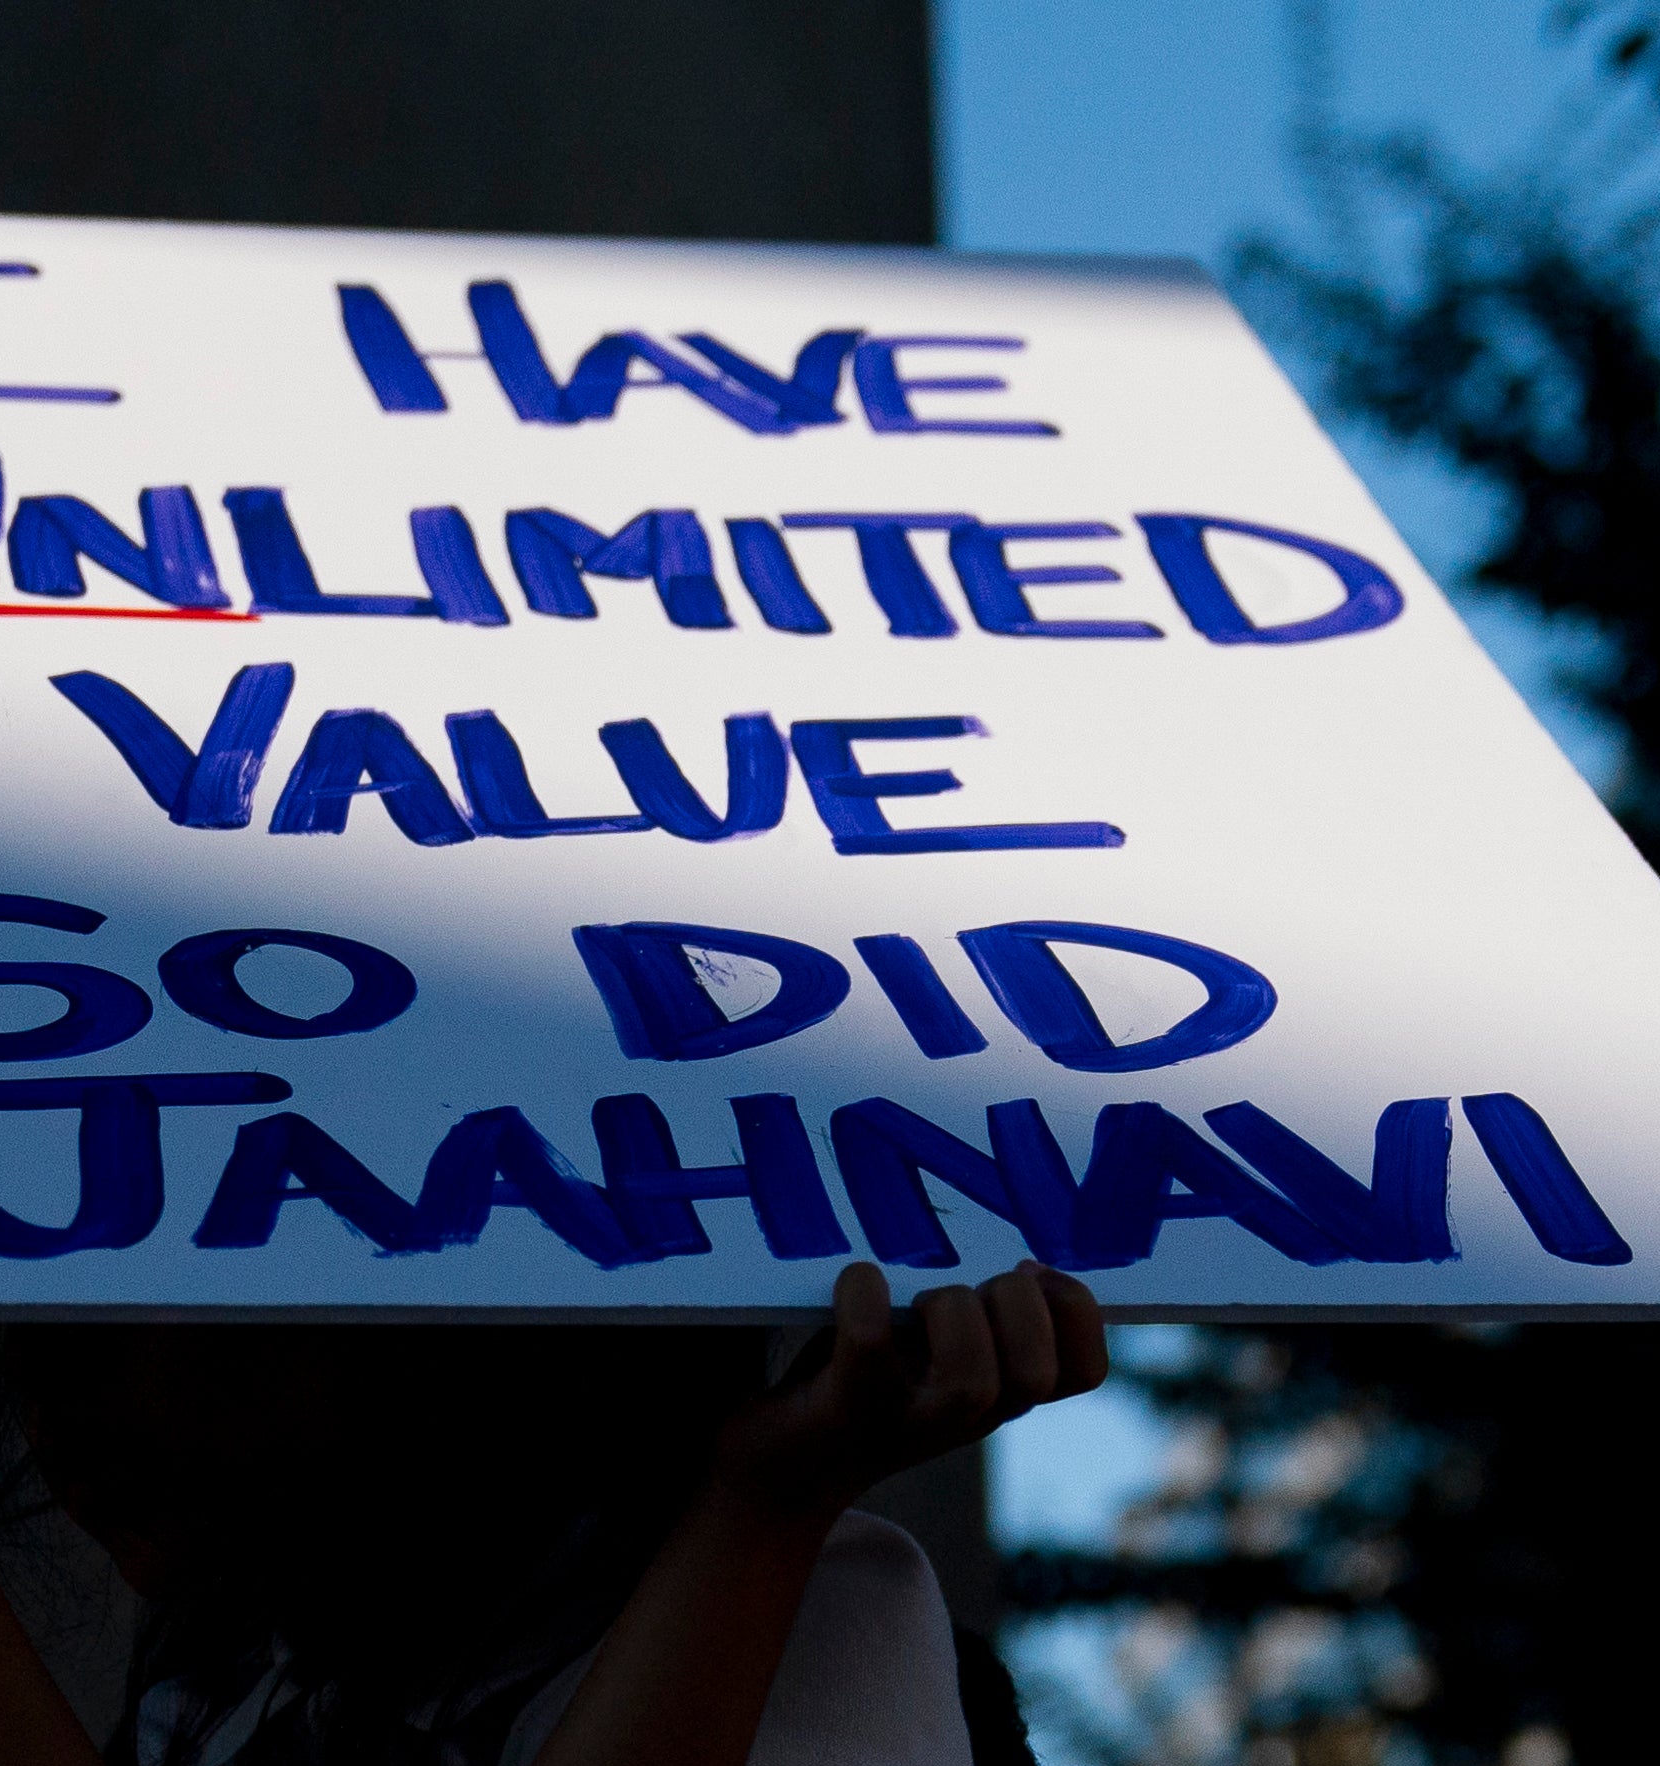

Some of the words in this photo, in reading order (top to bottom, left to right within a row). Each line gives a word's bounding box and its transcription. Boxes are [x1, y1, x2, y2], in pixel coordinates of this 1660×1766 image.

[339, 279, 1062, 436] HAVE
[49, 661, 1126, 856] VALUE
[572, 921, 1278, 1074] DID
